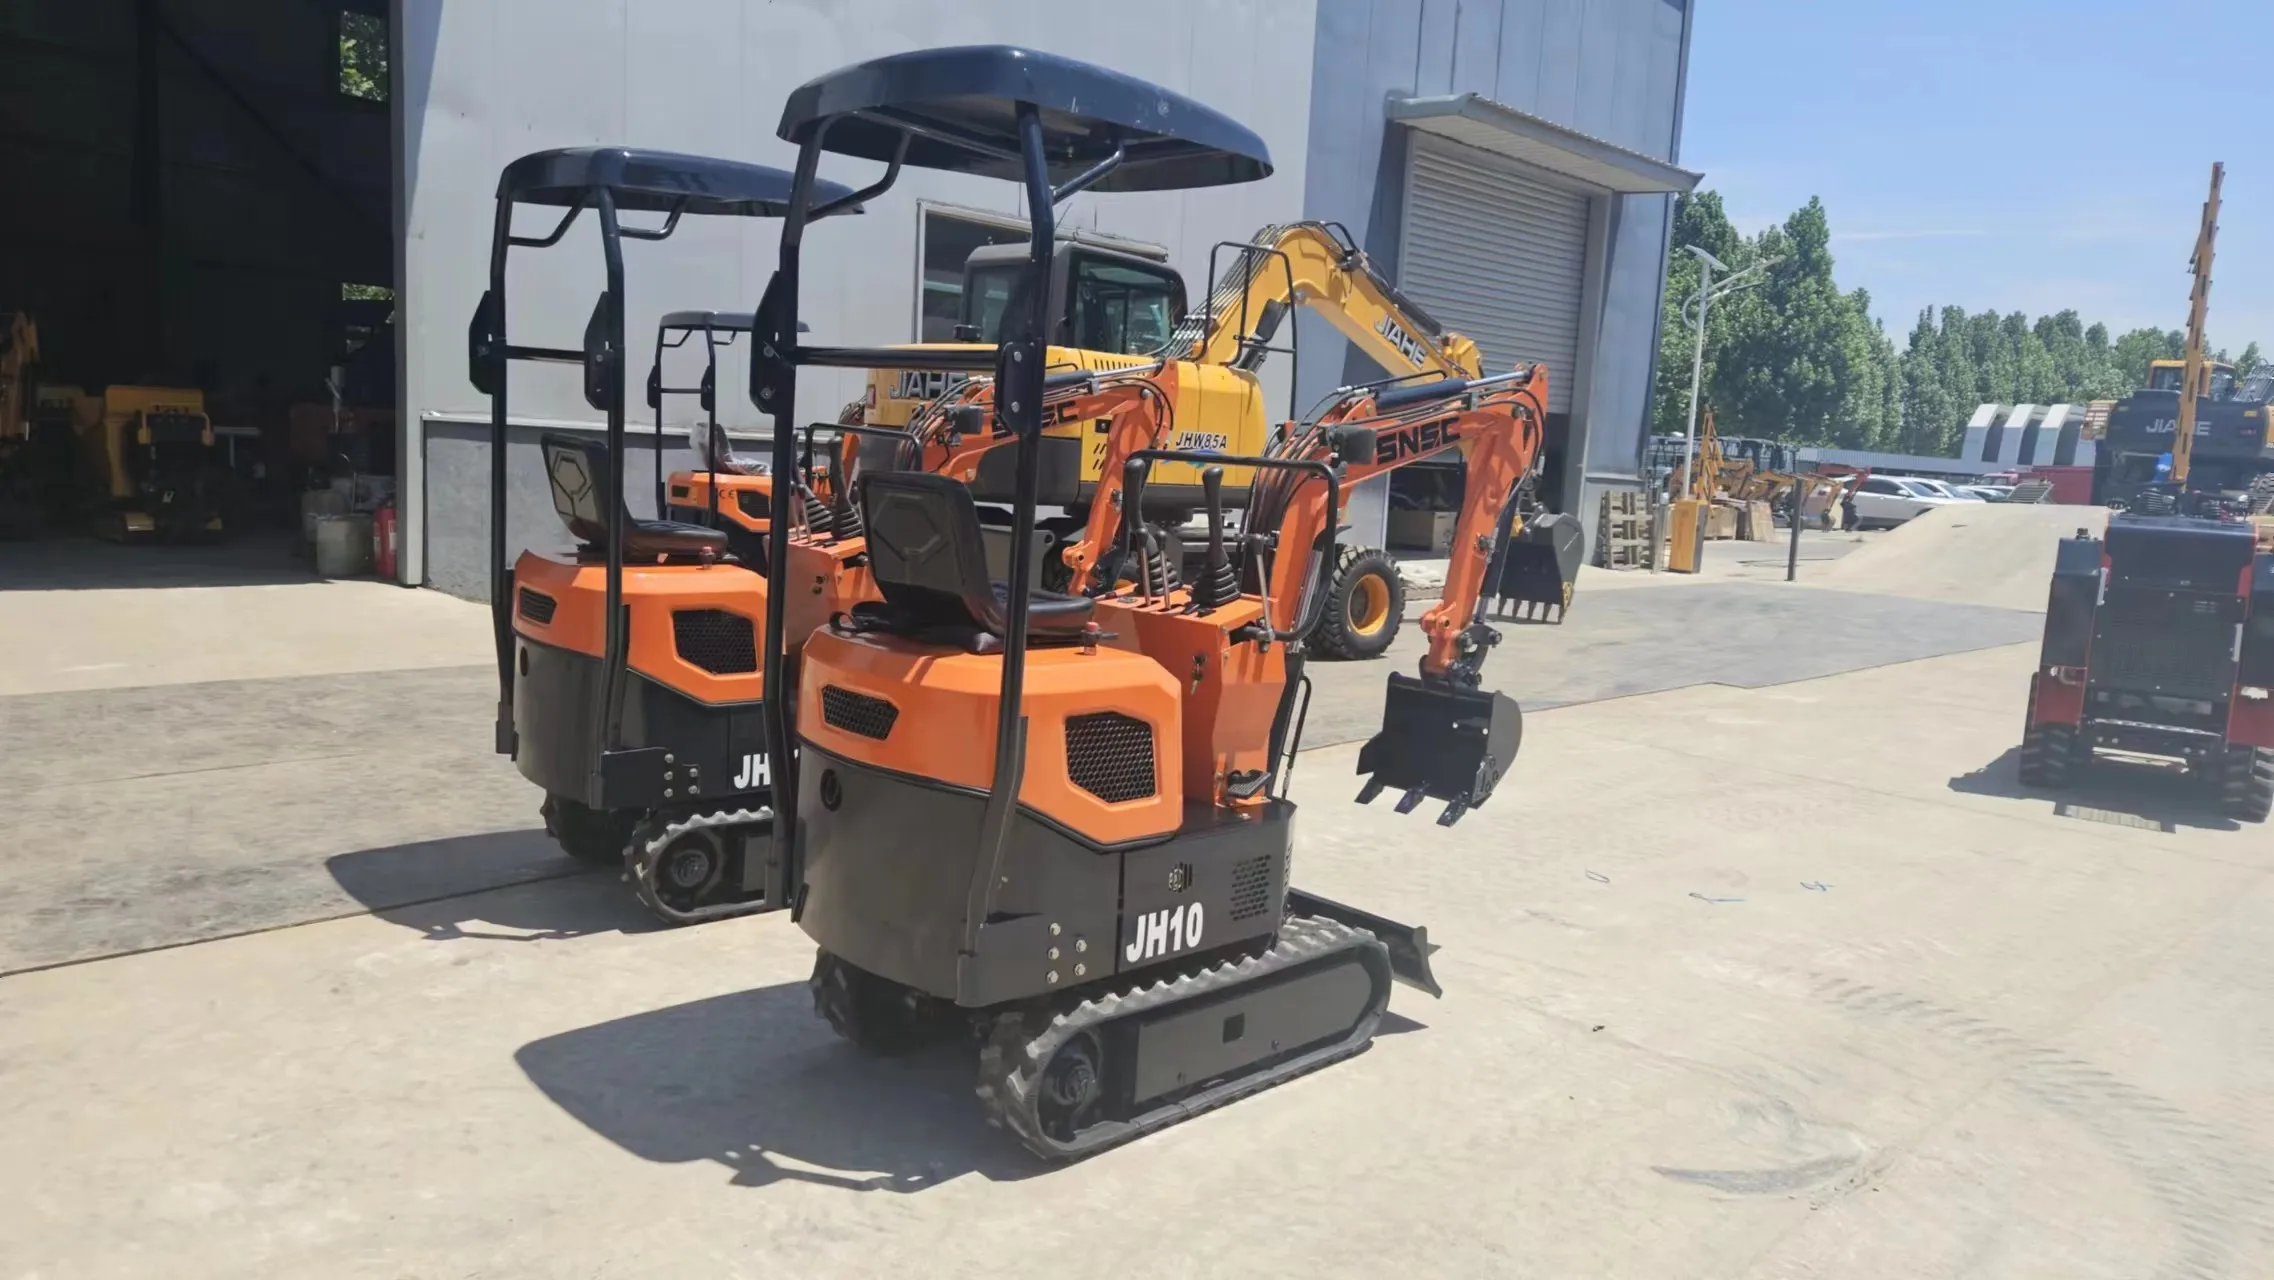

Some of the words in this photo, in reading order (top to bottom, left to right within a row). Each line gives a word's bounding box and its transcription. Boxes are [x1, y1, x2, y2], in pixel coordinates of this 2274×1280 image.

[1375, 314, 1428, 370] JIAHE
[1175, 431, 1228, 450] JHW85A
[2145, 418, 2213, 436] JIAE
[1126, 901, 1204, 963] JH10
